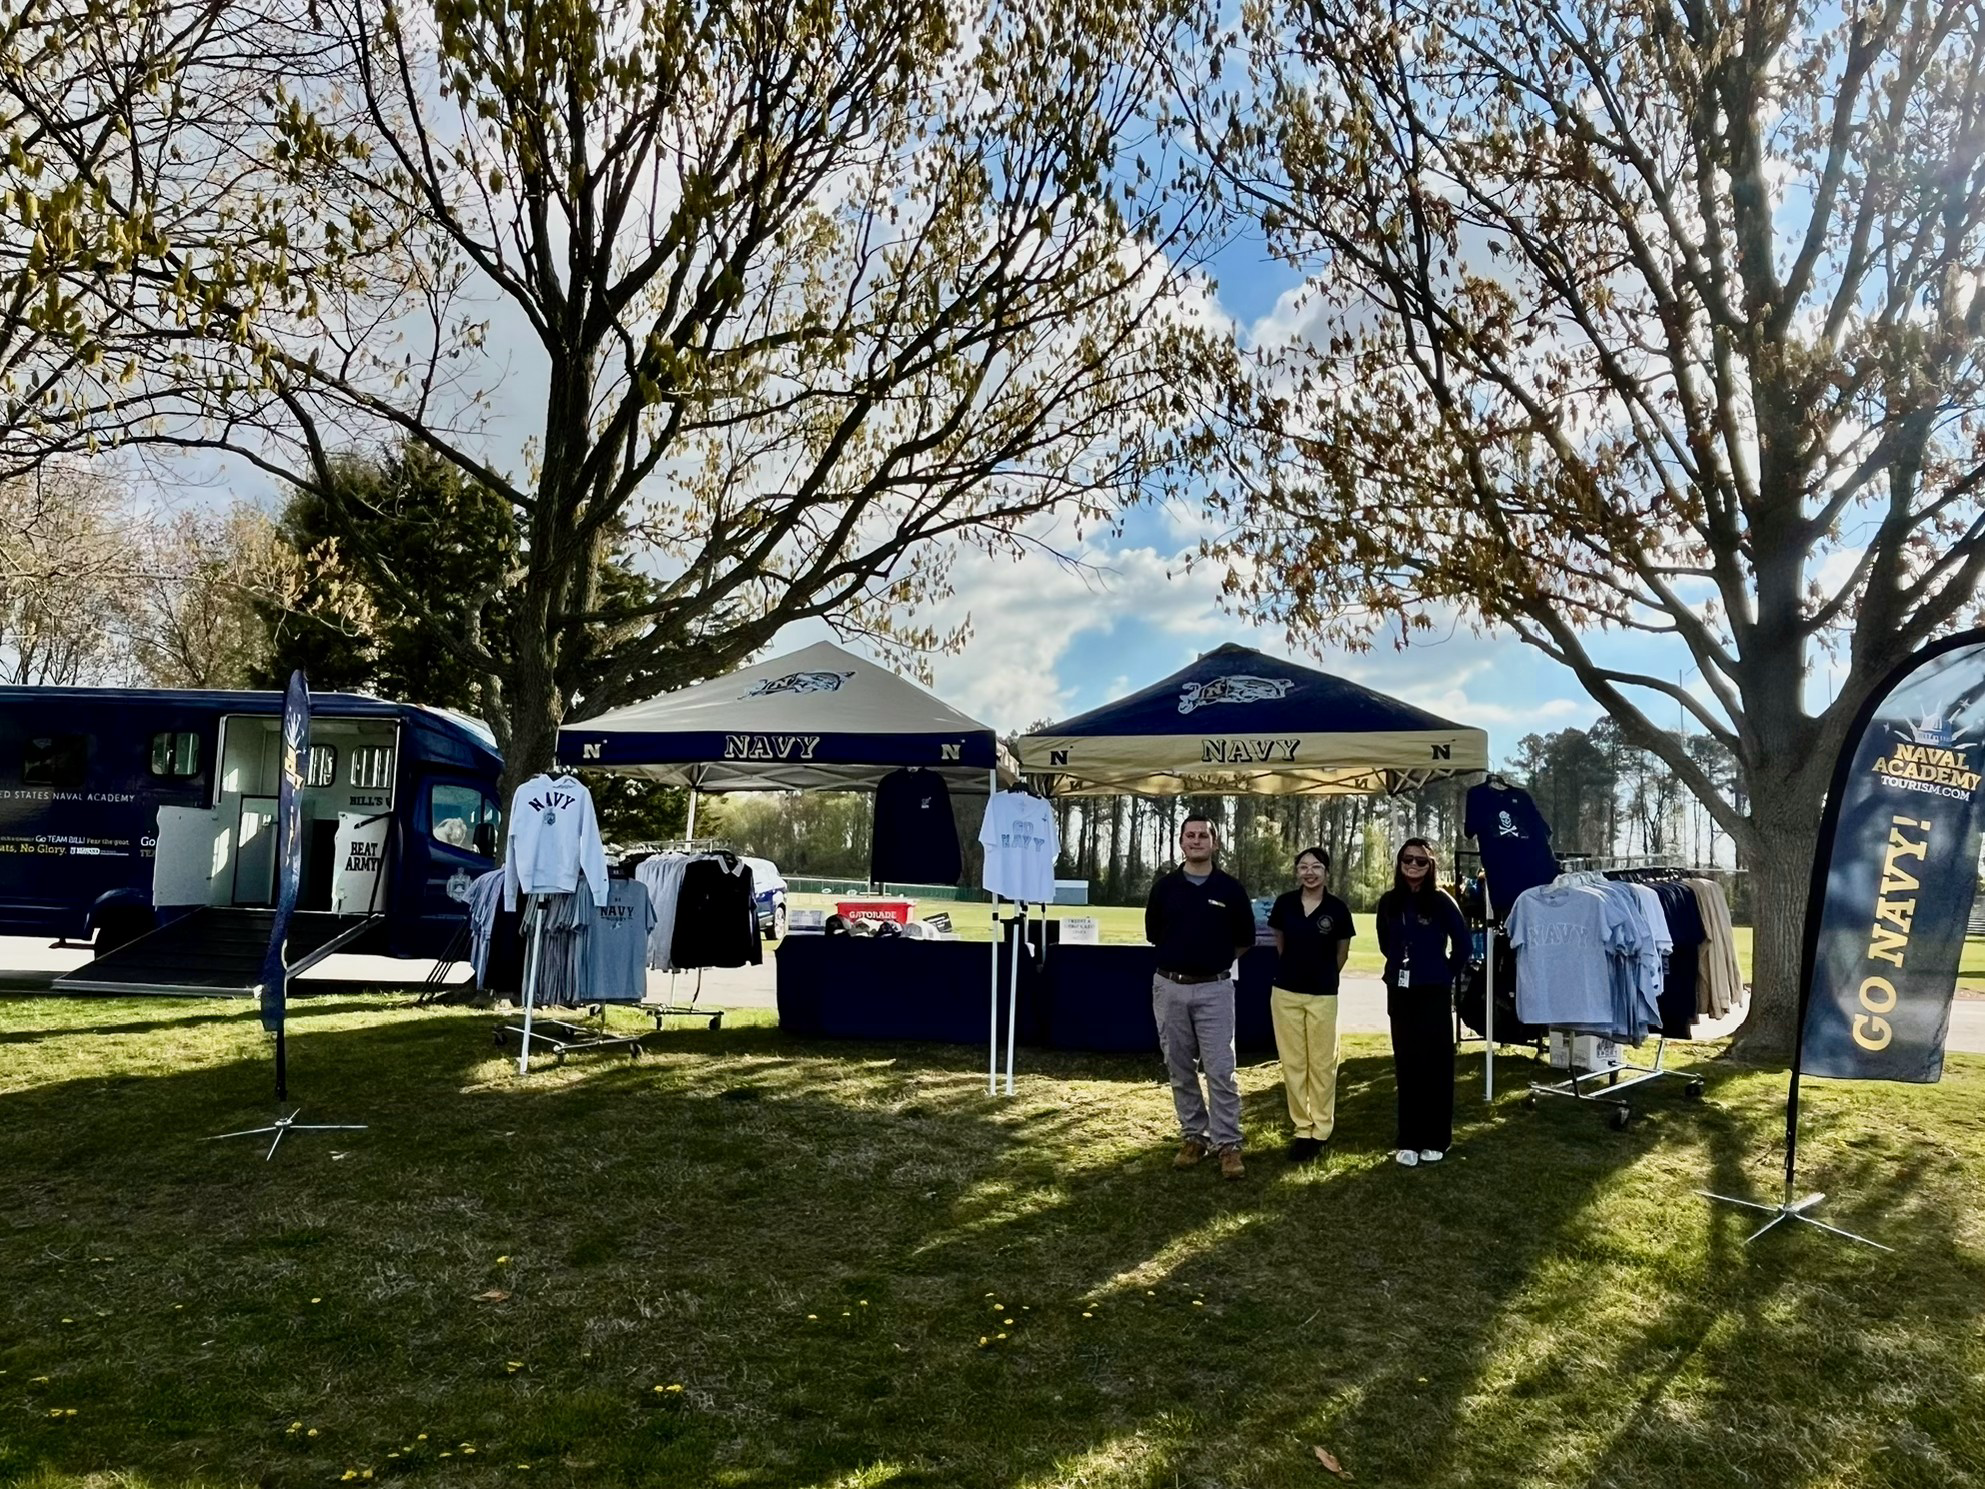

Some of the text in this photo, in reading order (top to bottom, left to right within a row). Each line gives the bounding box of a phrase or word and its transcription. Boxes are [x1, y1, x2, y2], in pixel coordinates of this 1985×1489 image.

[583, 743, 601, 759] N
[724, 735, 820, 759] NAVY
[941, 744, 961, 760] N
[1201, 739, 1300, 763] NAVY
[1431, 744, 1451, 760] N
[1050, 750, 1069, 766] N
[1893, 743, 1970, 771] NAVAL
[1872, 757, 1982, 791] ACADEMY
[15, 790, 50, 801] STATES
[52, 792, 83, 801] NAVAL
[87, 793, 135, 803] ACADEMY
[1881, 775, 1971, 802] TOURISM.COM
[528, 791, 576, 812] NAVY
[1012, 820, 1034, 836] GO
[47, 835, 68, 843] TEAM
[140, 836, 156, 847] Go
[1001, 834, 1045, 852] NAVY
[20, 843, 35, 853] No
[37, 844, 67, 856] Glory.
[350, 841, 379, 857] BEAT
[345, 856, 380, 872] ARMY
[600, 905, 634, 917] NAVY
[849, 910, 897, 920] GATORADE
[1526, 922, 1591, 948] NAVY
[1852, 815, 1931, 1051] GO NAVY!
